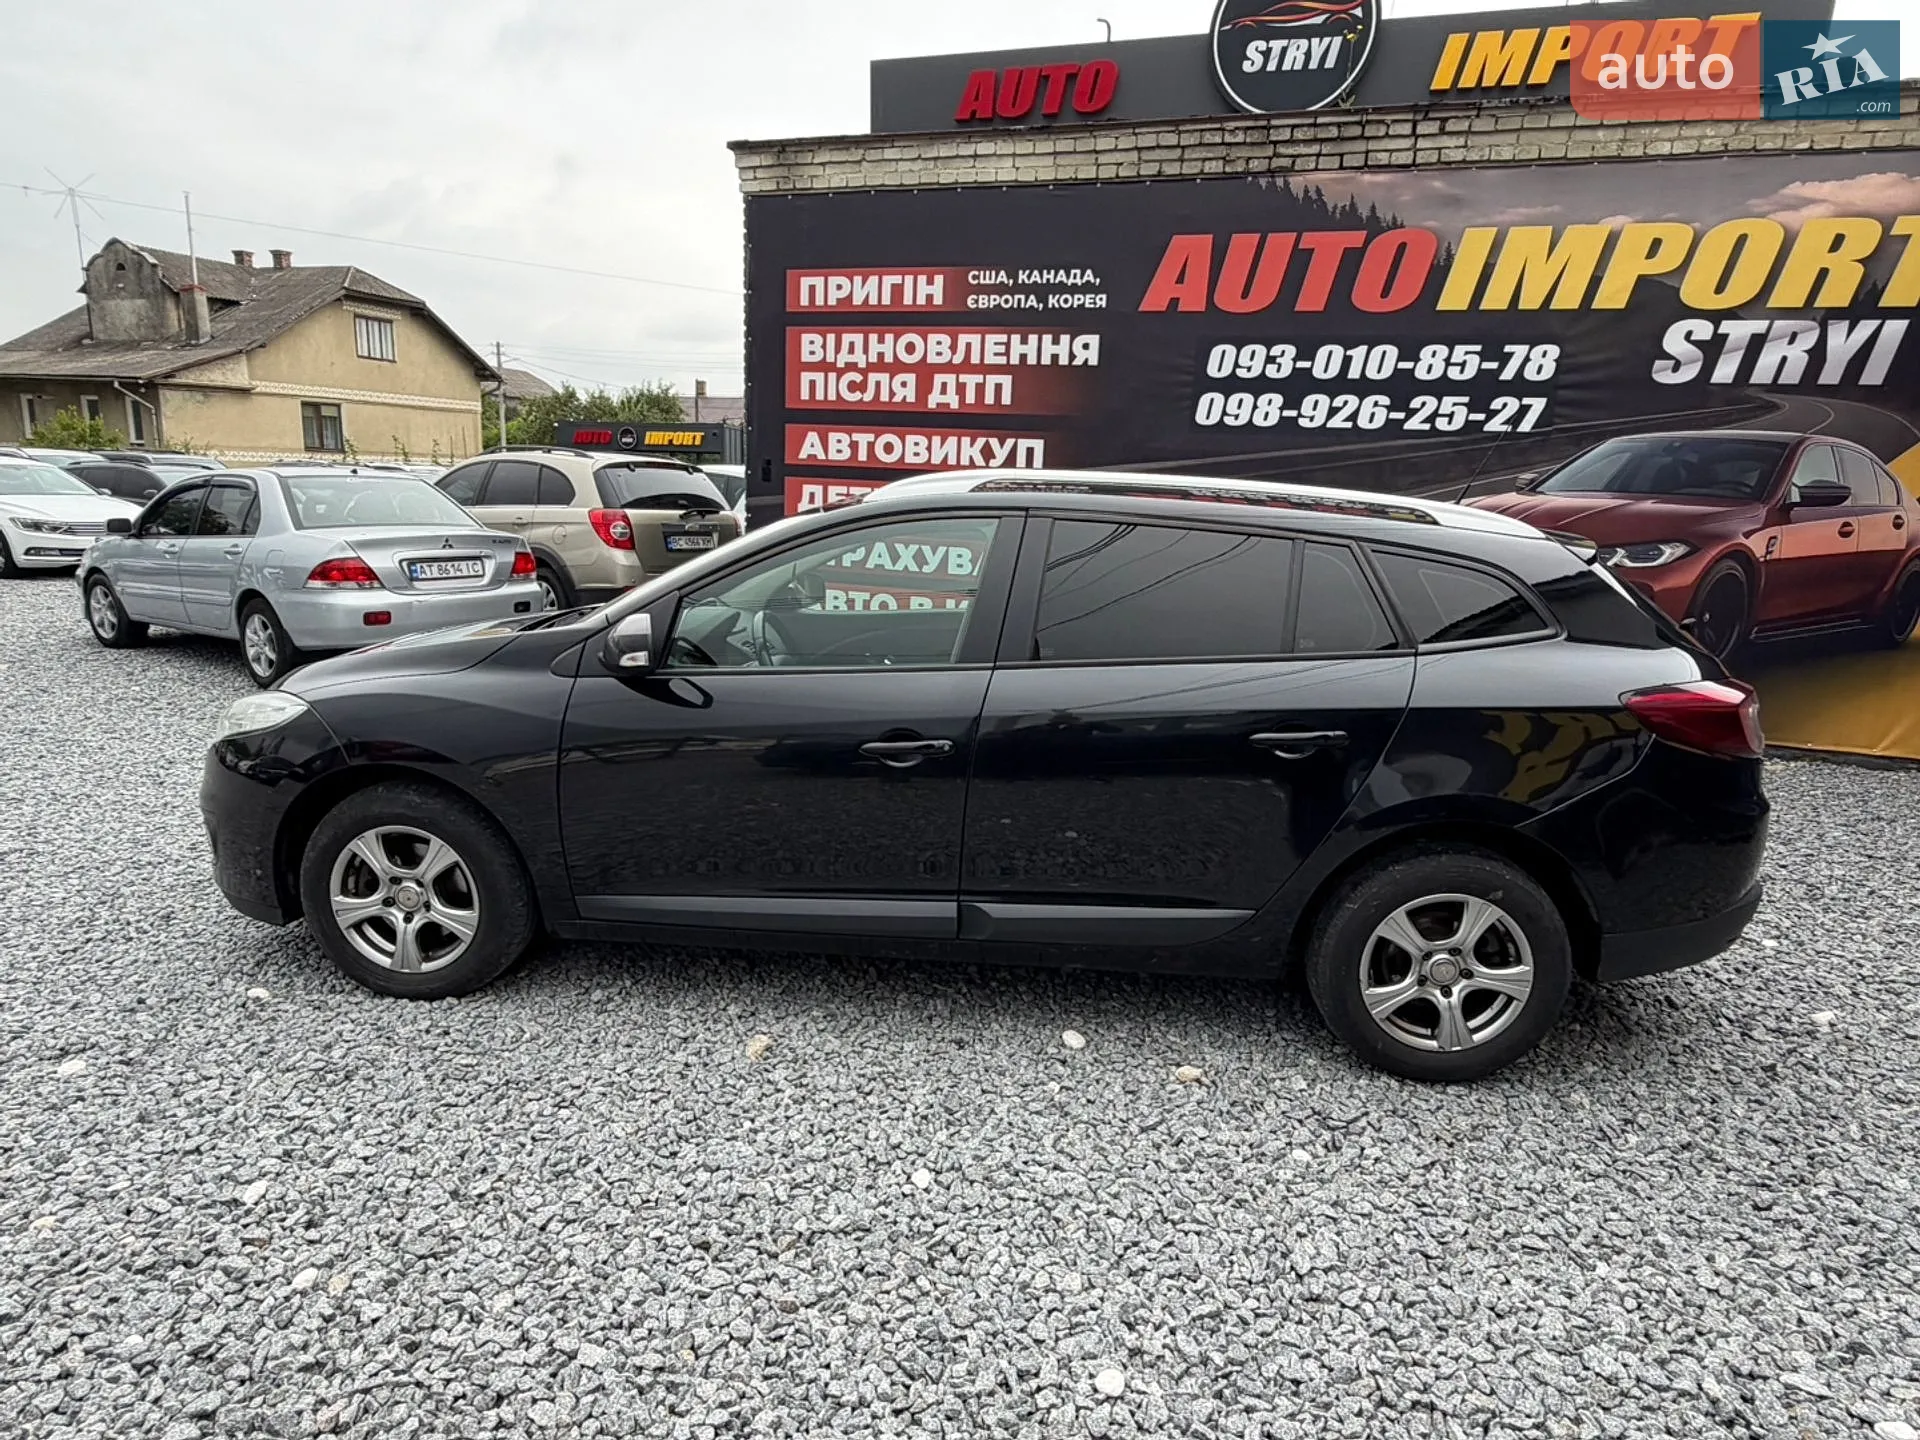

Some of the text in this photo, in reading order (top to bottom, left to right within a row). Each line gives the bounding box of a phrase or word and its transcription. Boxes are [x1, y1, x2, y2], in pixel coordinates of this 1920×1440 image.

[1241, 36, 1343, 73] STRYI
[1429, 12, 1762, 92] IMPORT
[954, 58, 1119, 123] AUTO
[800, 274, 944, 306] ПРИГІН
[967, 269, 1100, 286] США, КАНАДА,
[967, 294, 1107, 311] ЄВРОПА, КОРЕЯ
[800, 332, 1100, 368] ВІДНОВЛЕННЯ
[1206, 343, 1560, 382] 093-010-85-78
[1651, 318, 1910, 385] STRYI
[800, 371, 1013, 409] ПІСЛЯ ДТП
[1195, 392, 1548, 433] 098-926-25-27
[573, 429, 705, 446] AUTO IMPORT
[798, 431, 1045, 469] АВТОВИКУП
